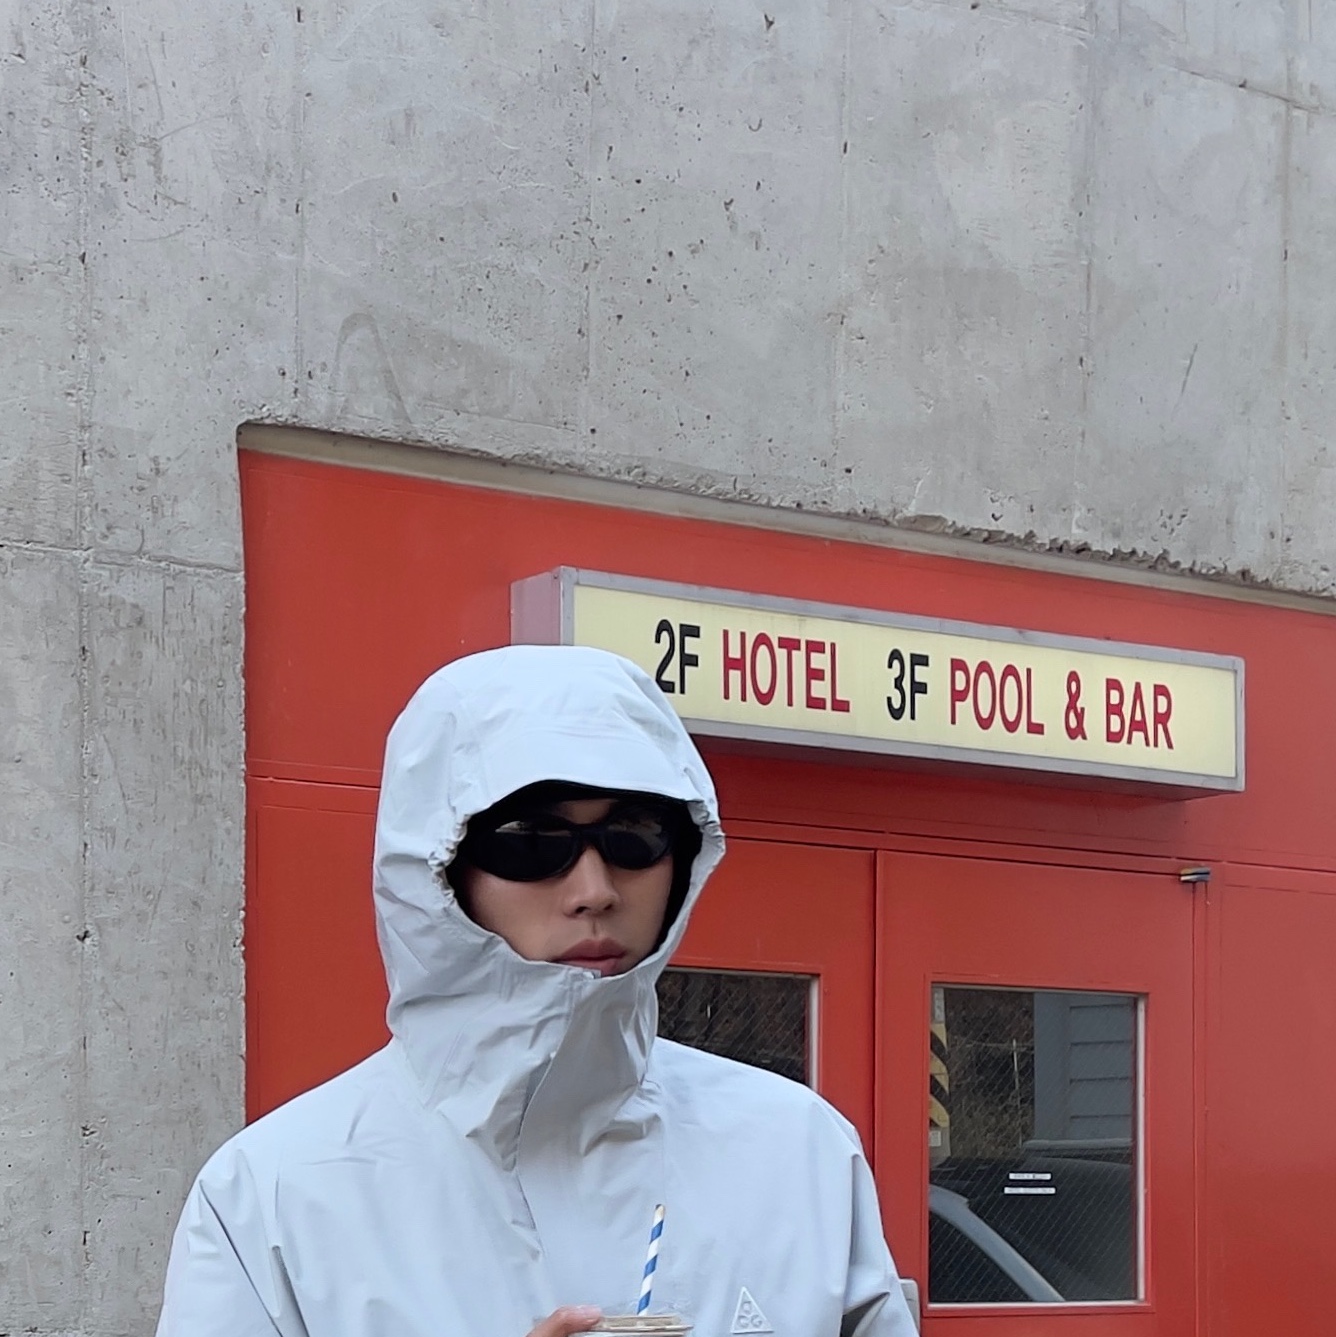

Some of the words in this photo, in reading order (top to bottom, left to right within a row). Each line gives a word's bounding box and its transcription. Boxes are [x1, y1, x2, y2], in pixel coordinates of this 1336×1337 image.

[654, 618, 701, 695] 2F
[722, 628, 851, 714] HOTEL
[886, 648, 930, 721] 3F
[950, 657, 1045, 736] POOL
[1064, 670, 1088, 741] &
[1105, 677, 1174, 750] BAR
